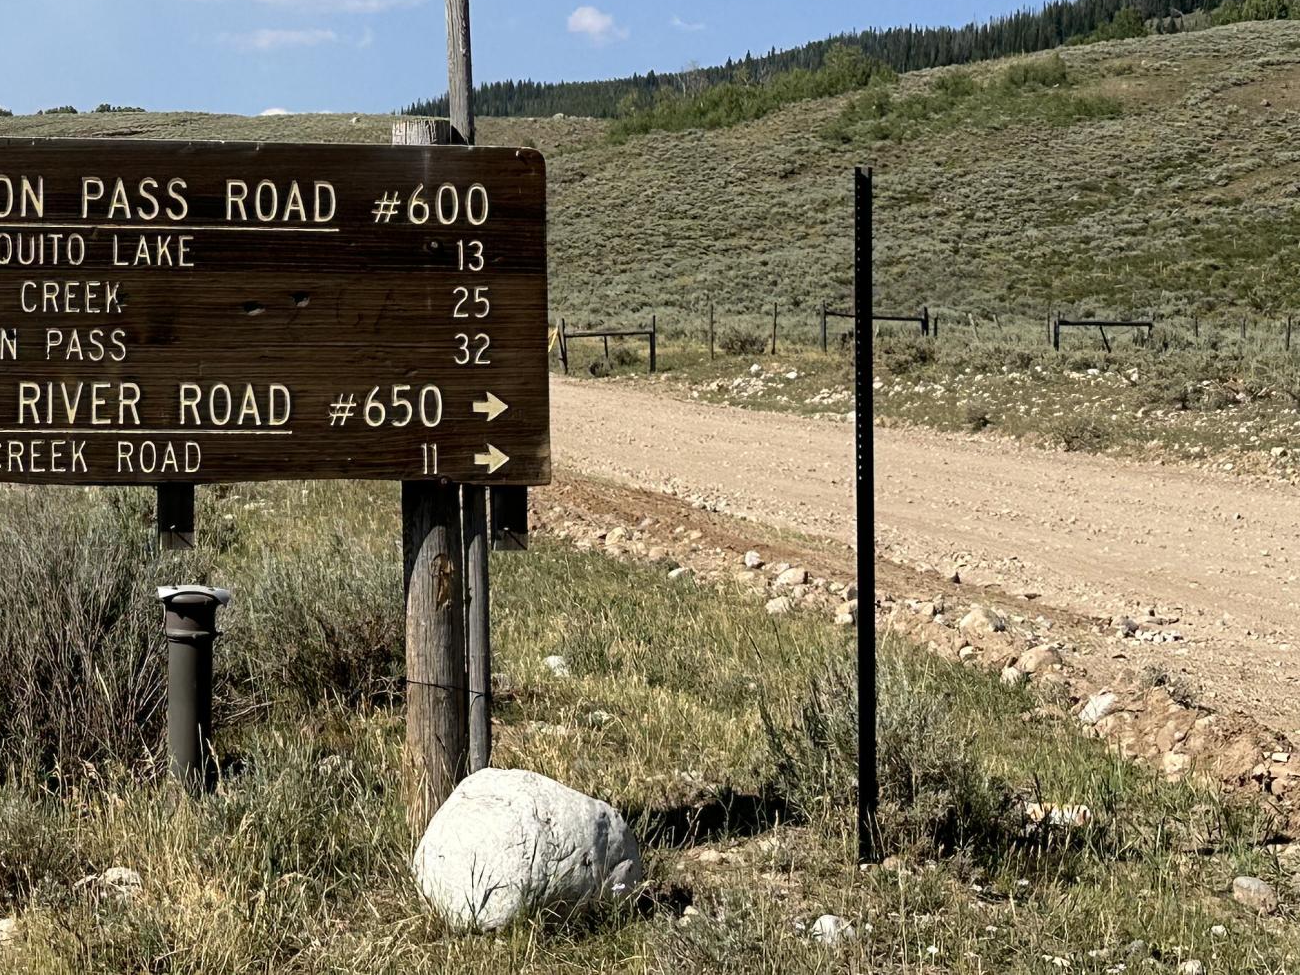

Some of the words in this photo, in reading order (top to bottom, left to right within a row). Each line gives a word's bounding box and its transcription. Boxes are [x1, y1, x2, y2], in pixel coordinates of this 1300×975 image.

[81, 176, 189, 220] PASS
[226, 179, 337, 223] ROAD
[371, 182, 489, 225] #600
[112, 234, 195, 267] LAKE
[457, 239, 485, 271] 13
[21, 280, 124, 313] CREEK
[453, 286, 491, 318] 25
[46, 328, 127, 362] PASS
[453, 333, 491, 365] 32
[18, 382, 142, 425] RIVER
[179, 383, 291, 426] ROAD
[328, 384, 443, 427] #650
[116, 441, 202, 473] ROAD
[420, 442, 439, 475] 11
